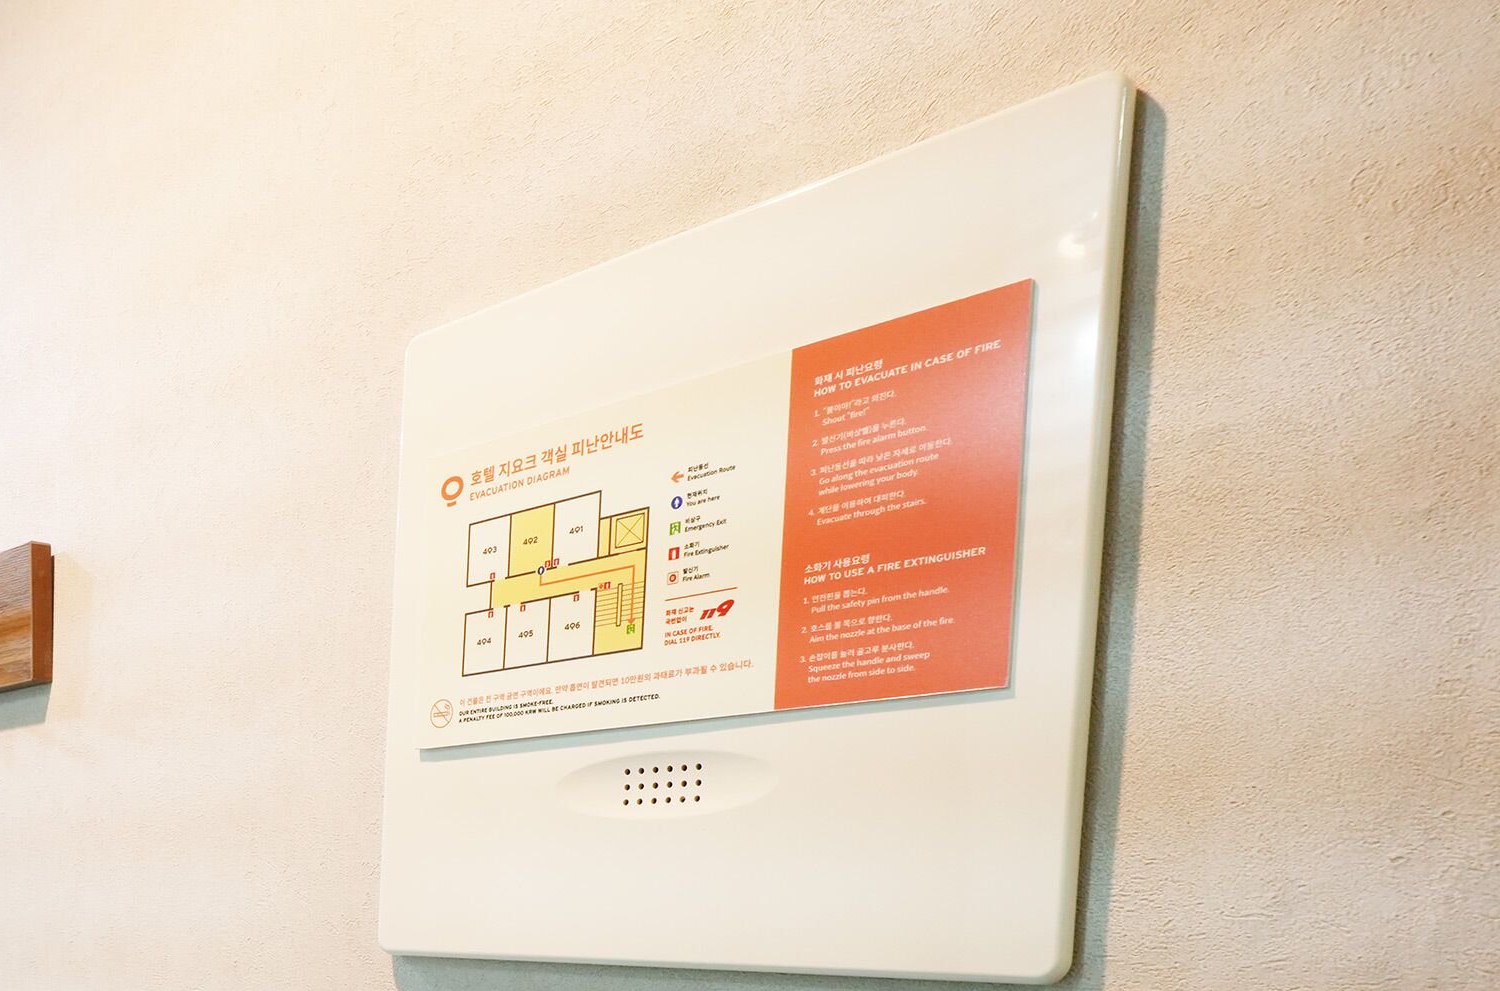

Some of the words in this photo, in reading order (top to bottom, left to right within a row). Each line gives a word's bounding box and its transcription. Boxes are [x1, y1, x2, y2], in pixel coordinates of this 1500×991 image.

[814, 385, 836, 397] HOW
[840, 381, 852, 390] TO
[855, 365, 907, 386] EVACUATE
[911, 362, 922, 371] IN
[925, 353, 953, 367] CASE
[957, 347, 971, 358] OF
[975, 340, 1001, 354] FIRE
[815, 373, 832, 385] 화재
[835, 370, 843, 379] 시
[846, 359, 883, 376] 피난요령
[822, 414, 845, 426] Shout
[821, 446, 841, 455] Press
[843, 441, 856, 450] the
[857, 438, 871, 447] fire
[872, 433, 896, 443] alarm
[471, 465, 494, 486] 호텔
[499, 455, 536, 477] 지요크
[541, 445, 567, 465] 객실
[572, 423, 643, 456] 피난안내도
[688, 470, 717, 481] Evacuation
[719, 465, 735, 473] Route
[819, 477, 829, 485] Go
[831, 473, 853, 482] along
[855, 468, 868, 477] the
[869, 459, 914, 474] evacuation
[916, 454, 939, 463] route
[470, 479, 524, 501] EVACUATION
[527, 466, 569, 485] DIAGRAM
[819, 486, 839, 495] while
[840, 479, 875, 491] lowering
[876, 474, 895, 485] your
[817, 514, 852, 525] Evacuate
[854, 506, 886, 518] through
[887, 503, 901, 511] the
[685, 522, 714, 532] Emergency
[717, 518, 726, 526] Exit
[685, 541, 699, 549] 소화기
[695, 545, 729, 555] Extinguisher
[804, 574, 826, 584] HOW
[829, 571, 841, 580] TO
[844, 568, 864, 578] USE
[867, 565, 874, 574] A
[877, 561, 901, 572] FIRE
[904, 547, 986, 568] EXTINGUISHER
[805, 561, 831, 573] 소화기
[833, 554, 870, 568] 사용요령
[694, 572, 709, 580] Alarm
[700, 600, 734, 620] 119
[812, 605, 826, 614] Pull
[827, 603, 840, 611] the
[842, 600, 865, 609] safety
[867, 598, 880, 607] pin
[882, 594, 901, 602] from
[903, 591, 917, 599] the
[673, 628, 687, 636] CASE
[689, 626, 697, 634] OF
[810, 634, 824, 643] Aim
[826, 632, 838, 641] the
[840, 629, 865, 638] nozzle
[867, 627, 875, 635] at
[877, 625, 890, 634] the
[892, 623, 911, 632] base
[913, 619, 922, 628] of
[923, 619, 937, 627] the
[939, 616, 955, 624] fire.
[665, 638, 677, 646] DIAL
[679, 636, 690, 644] 119
[710, 664, 717, 672] 수
[809, 664, 841, 673] Squeeze
[842, 660, 855, 668] the
[857, 657, 884, 666] handle
[886, 654, 902, 663] and
[903, 652, 930, 661] sweep
[808, 675, 820, 683] the
[822, 672, 847, 681] nozzle
[848, 670, 867, 678] from
[869, 667, 885, 676] side
[887, 667, 895, 675] to
[459, 709, 469, 717] OUR
[470, 707, 487, 715] ENTIRE
[489, 704, 512, 712] BUILDING
[464, 715, 484, 723] PENALTY
[505, 710, 524, 718] 100,000
[560, 702, 586, 710] CHARGED
[594, 698, 620, 706] SMOKING
[629, 693, 659, 702] DETECTED.
